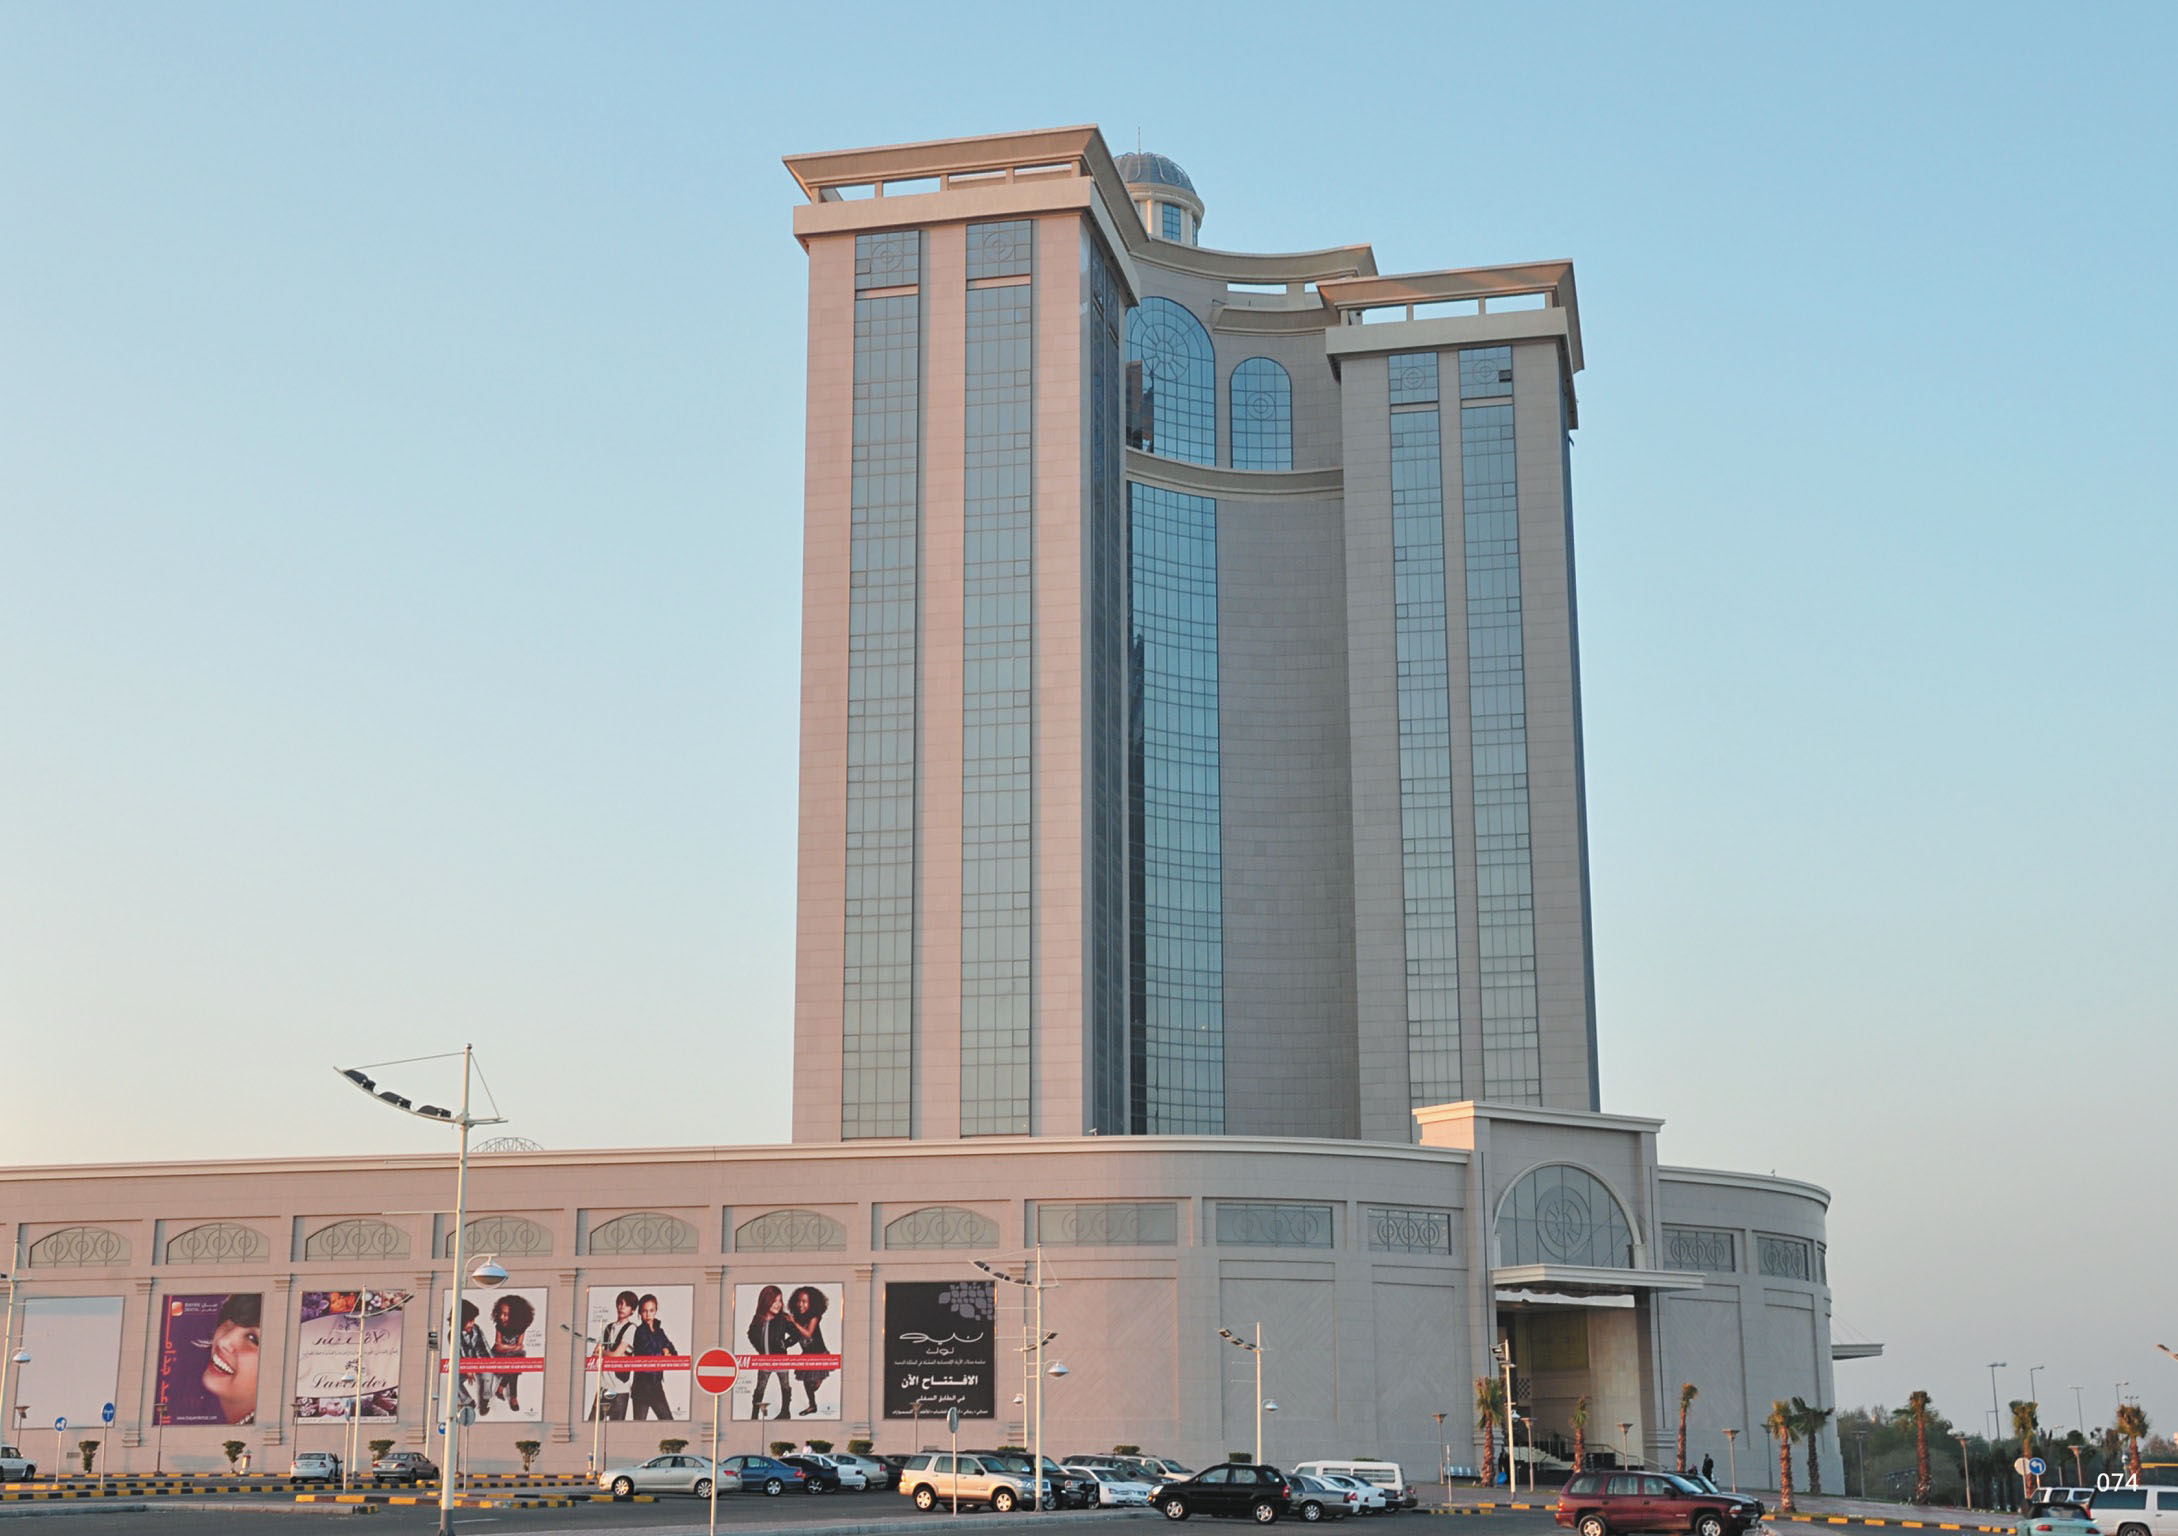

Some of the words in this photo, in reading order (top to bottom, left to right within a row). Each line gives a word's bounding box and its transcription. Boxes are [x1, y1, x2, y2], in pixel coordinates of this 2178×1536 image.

[901, 1373, 919, 1389] الآن
[921, 1375, 979, 1390] الافتتاح
[957, 1395, 966, 1403] في
